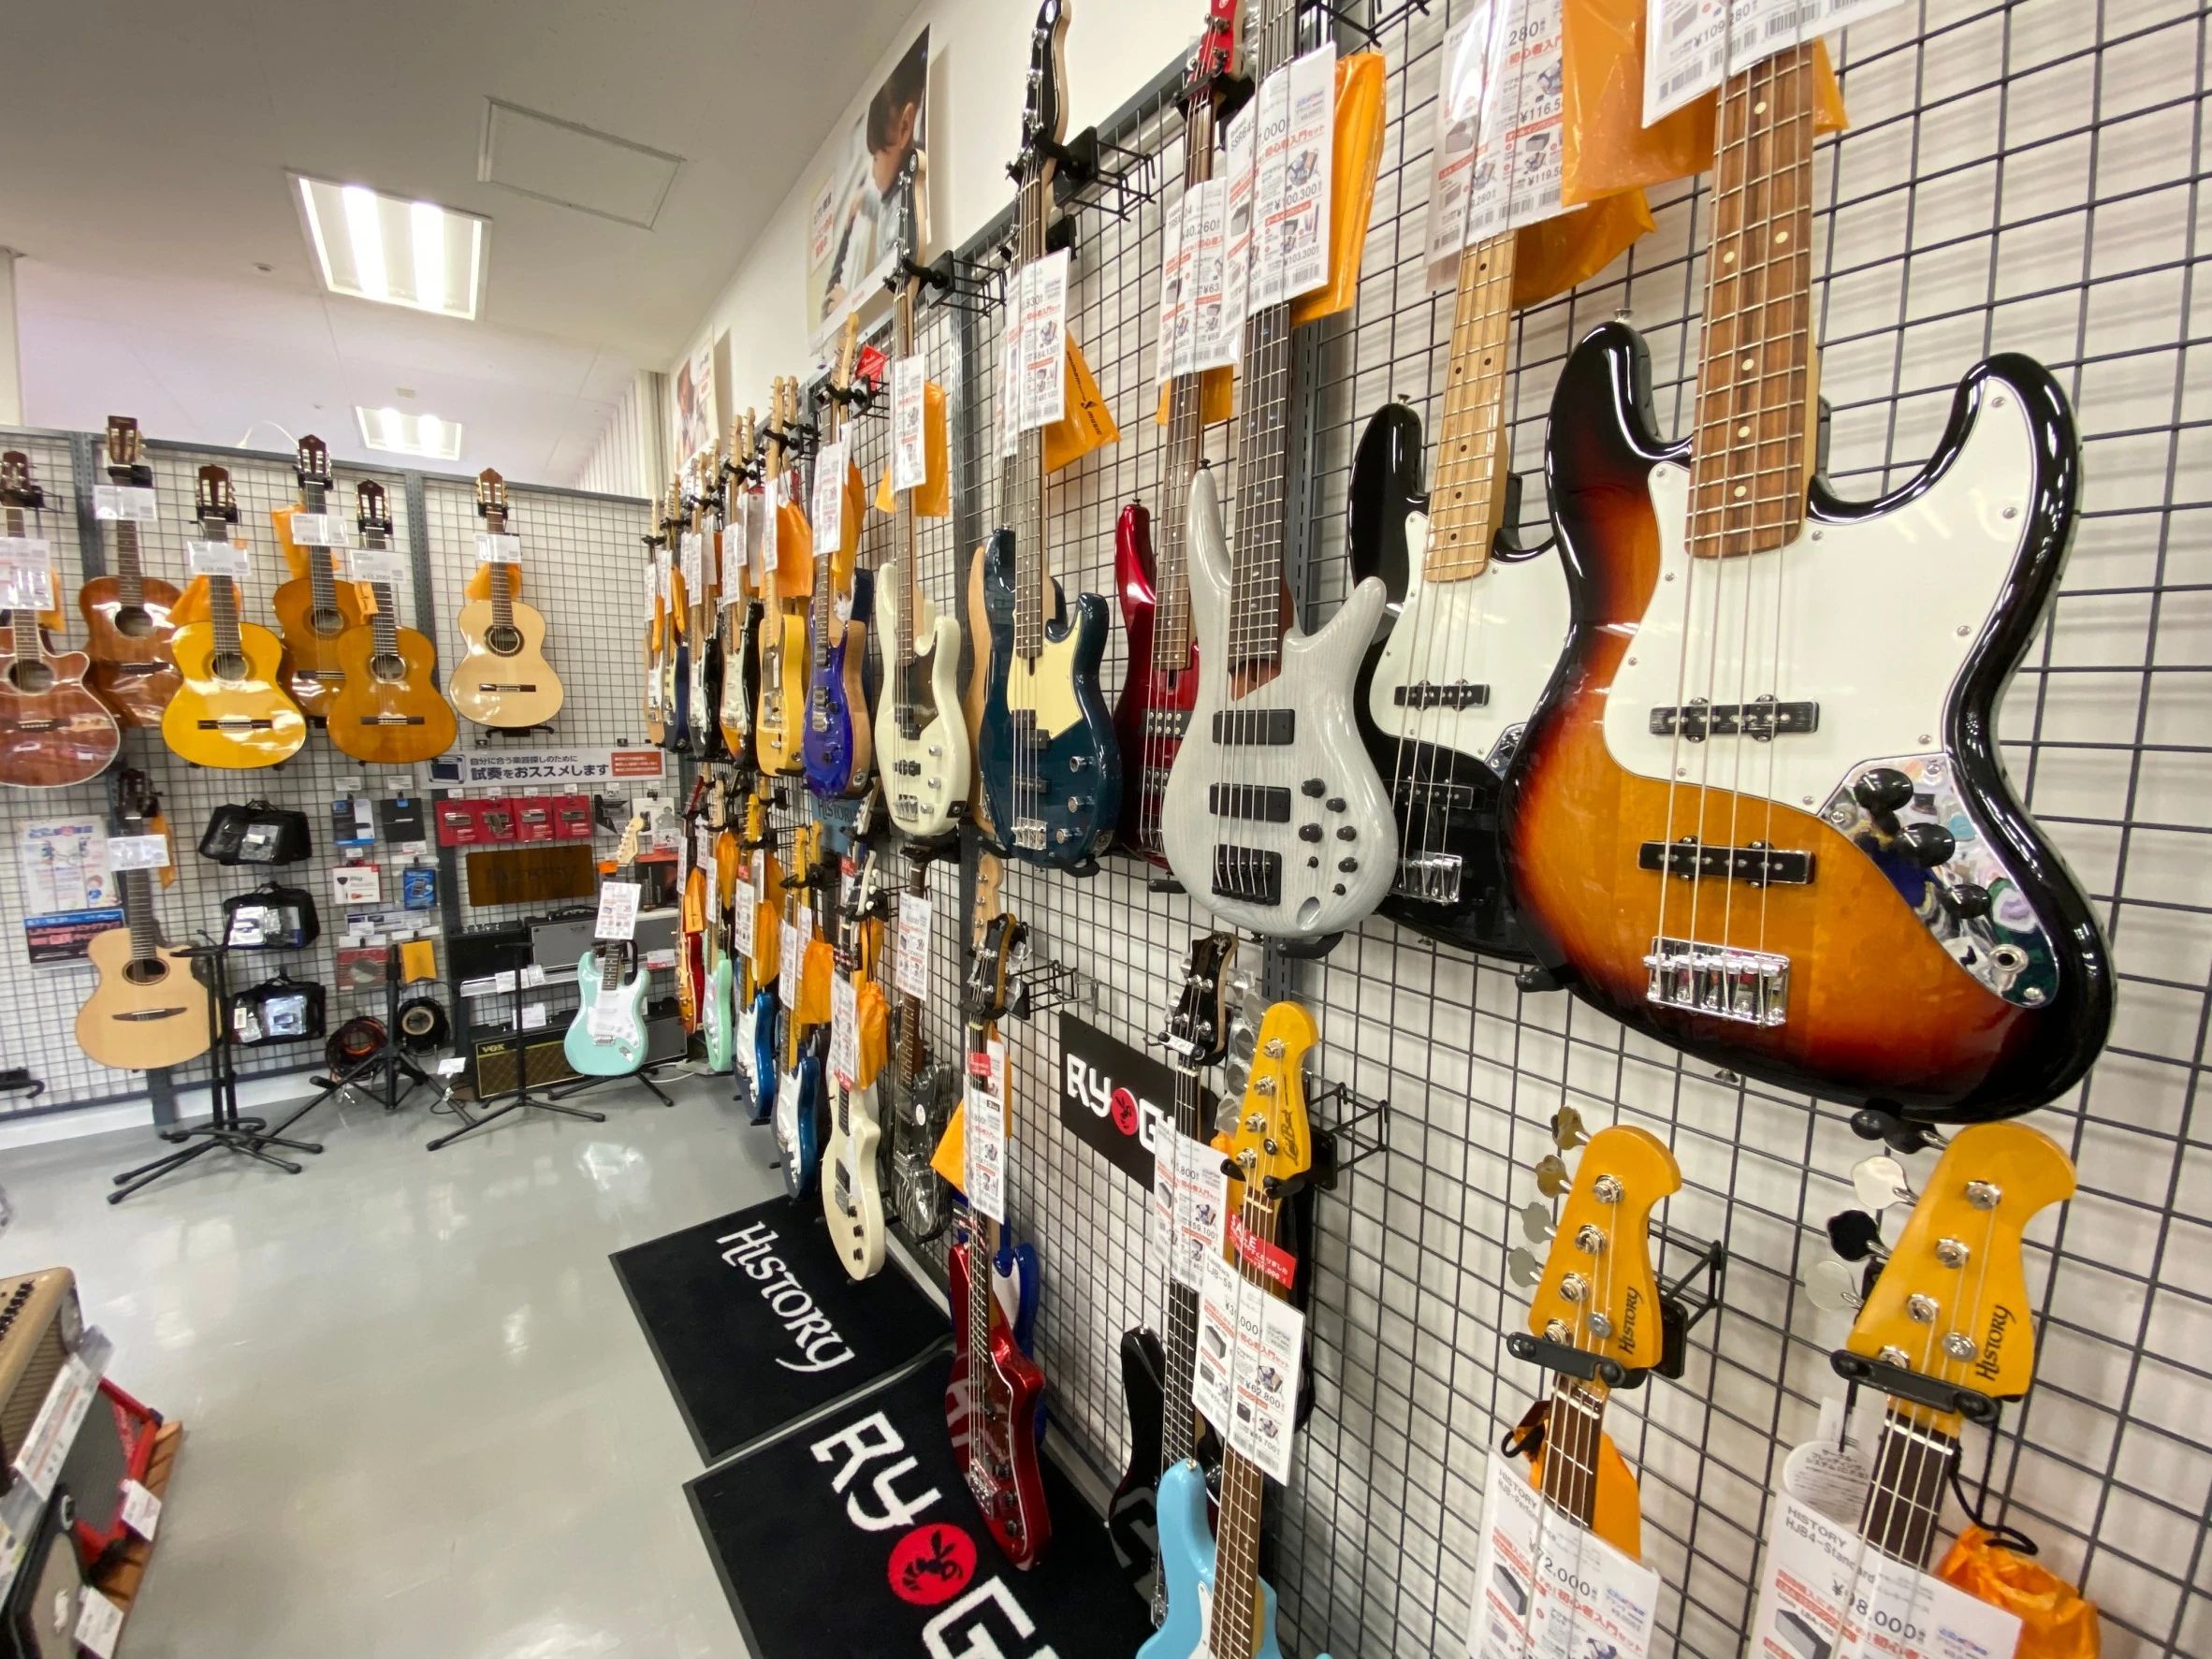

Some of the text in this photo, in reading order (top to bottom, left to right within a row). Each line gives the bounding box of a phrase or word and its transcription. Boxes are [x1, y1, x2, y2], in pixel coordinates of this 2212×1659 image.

[471, 764, 609, 781] 試奏をおススメします
[482, 1043, 505, 1054] VOX
[1230, 1213, 1258, 1248] SAE
[716, 1221, 855, 1373] HISTORY
[1618, 1286, 1642, 1357] HISTORY
[1975, 1304, 2016, 1383] HISTORY
[1787, 1506, 1848, 1548] HISTORY
